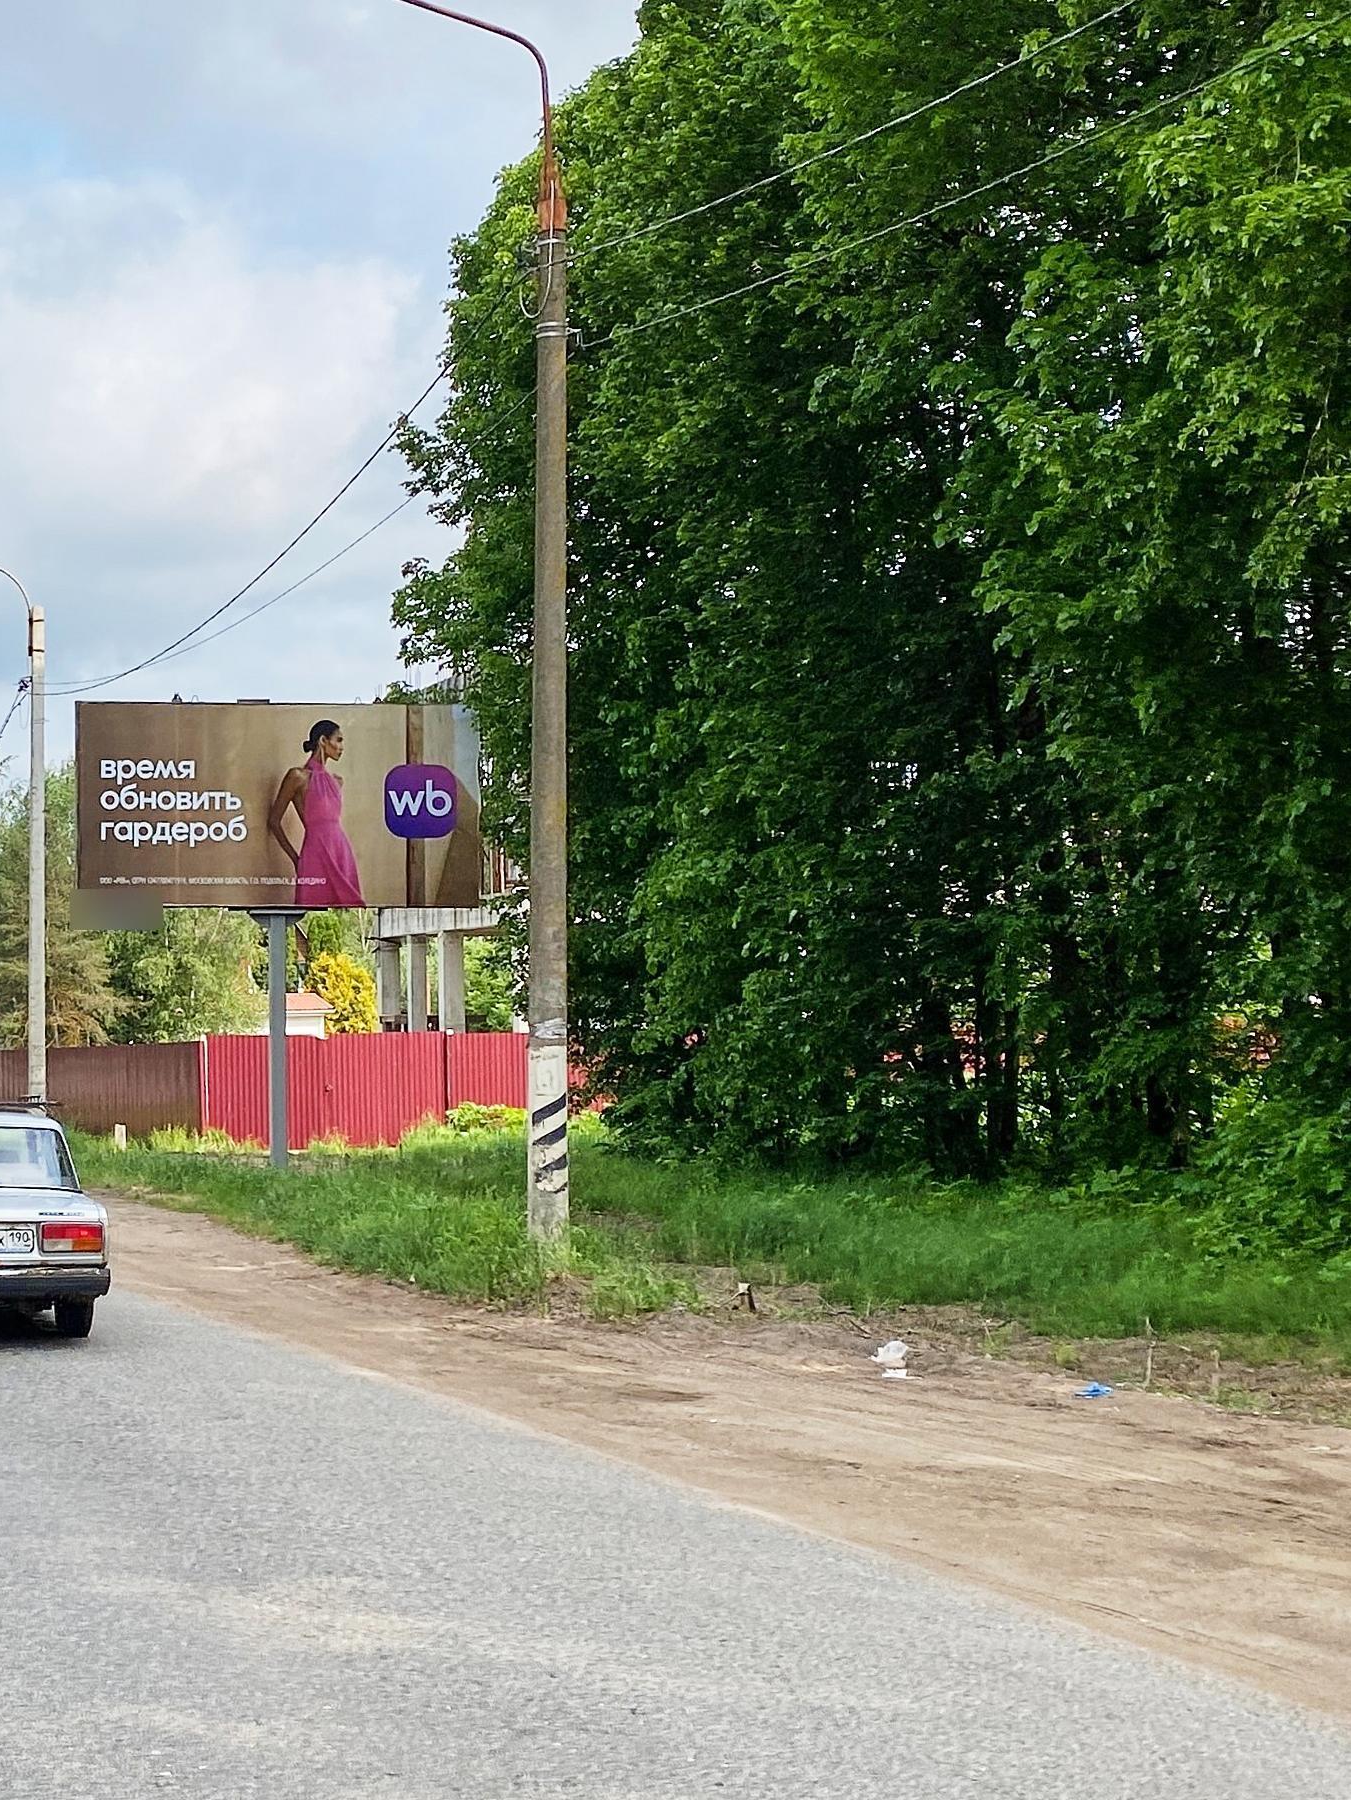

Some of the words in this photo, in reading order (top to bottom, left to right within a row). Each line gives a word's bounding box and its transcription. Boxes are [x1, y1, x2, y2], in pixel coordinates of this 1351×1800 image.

[100, 759, 195, 785] время
[100, 783, 242, 810] обновить
[388, 779, 453, 817] wb
[100, 815, 248, 847] гардероб
